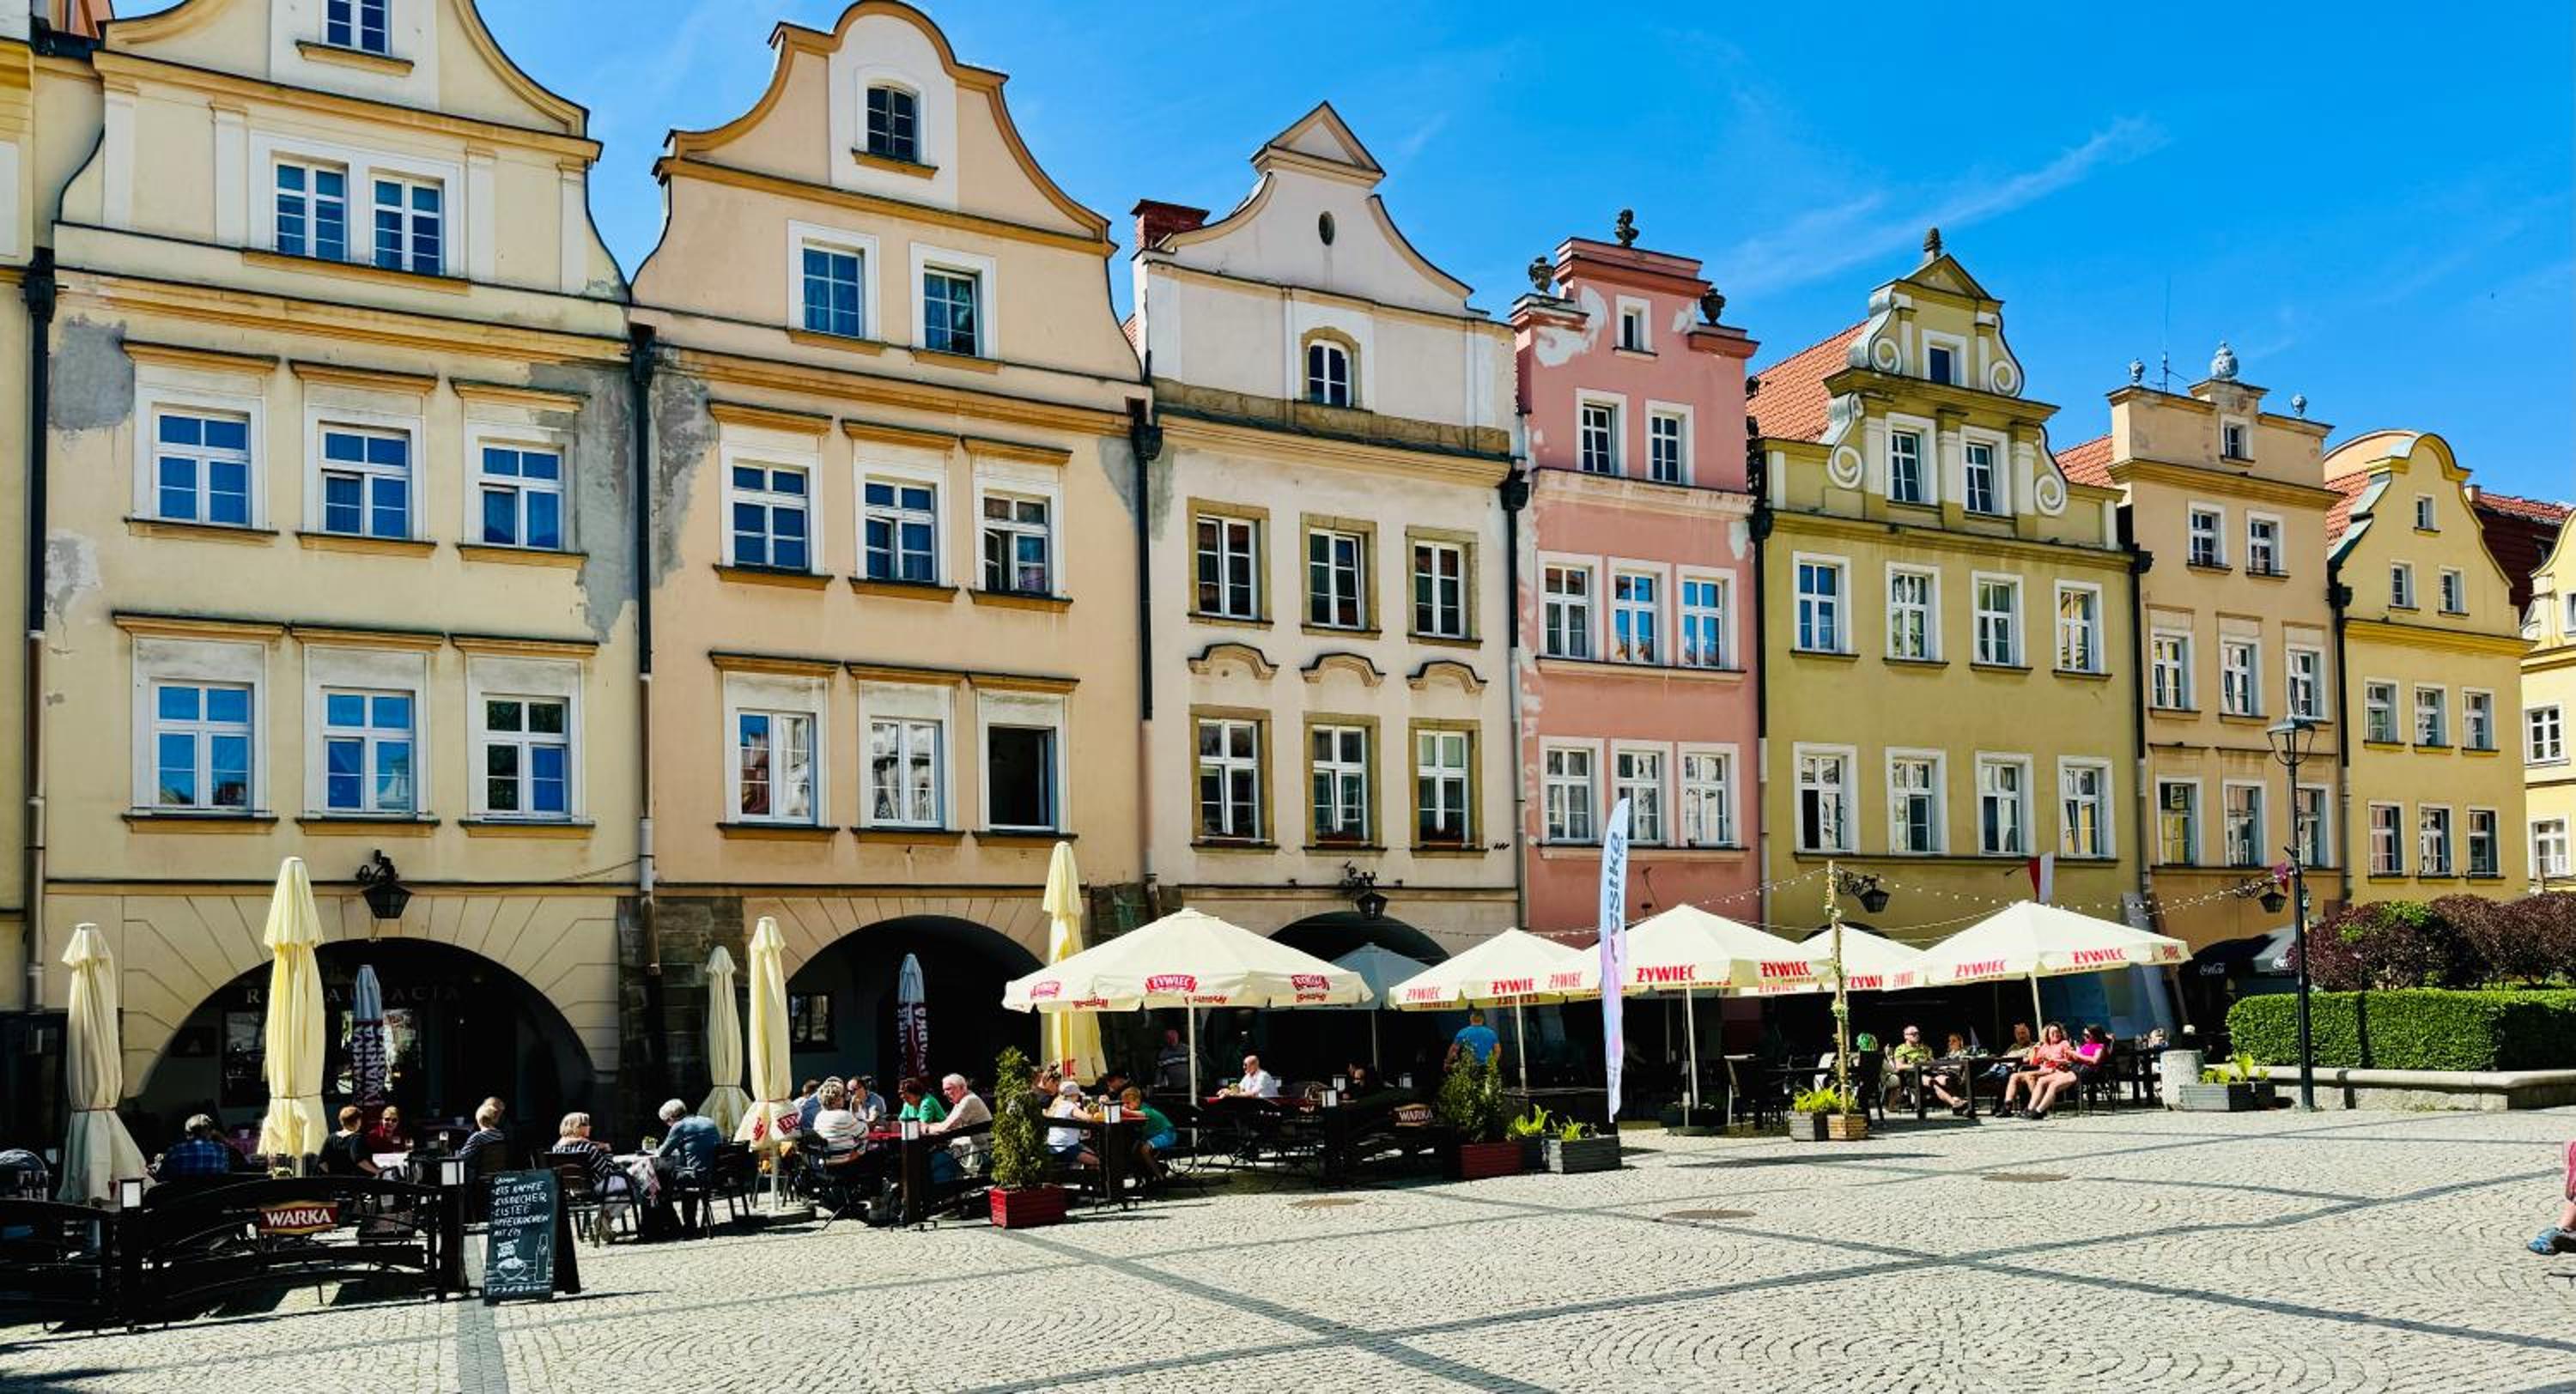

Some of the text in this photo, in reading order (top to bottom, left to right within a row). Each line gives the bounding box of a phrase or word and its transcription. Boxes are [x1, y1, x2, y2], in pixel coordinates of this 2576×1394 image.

[1492, 978, 1535, 996] ŻYWIE
[1850, 973, 1883, 990] ŻYWI
[266, 1209, 331, 1227] WARKA
